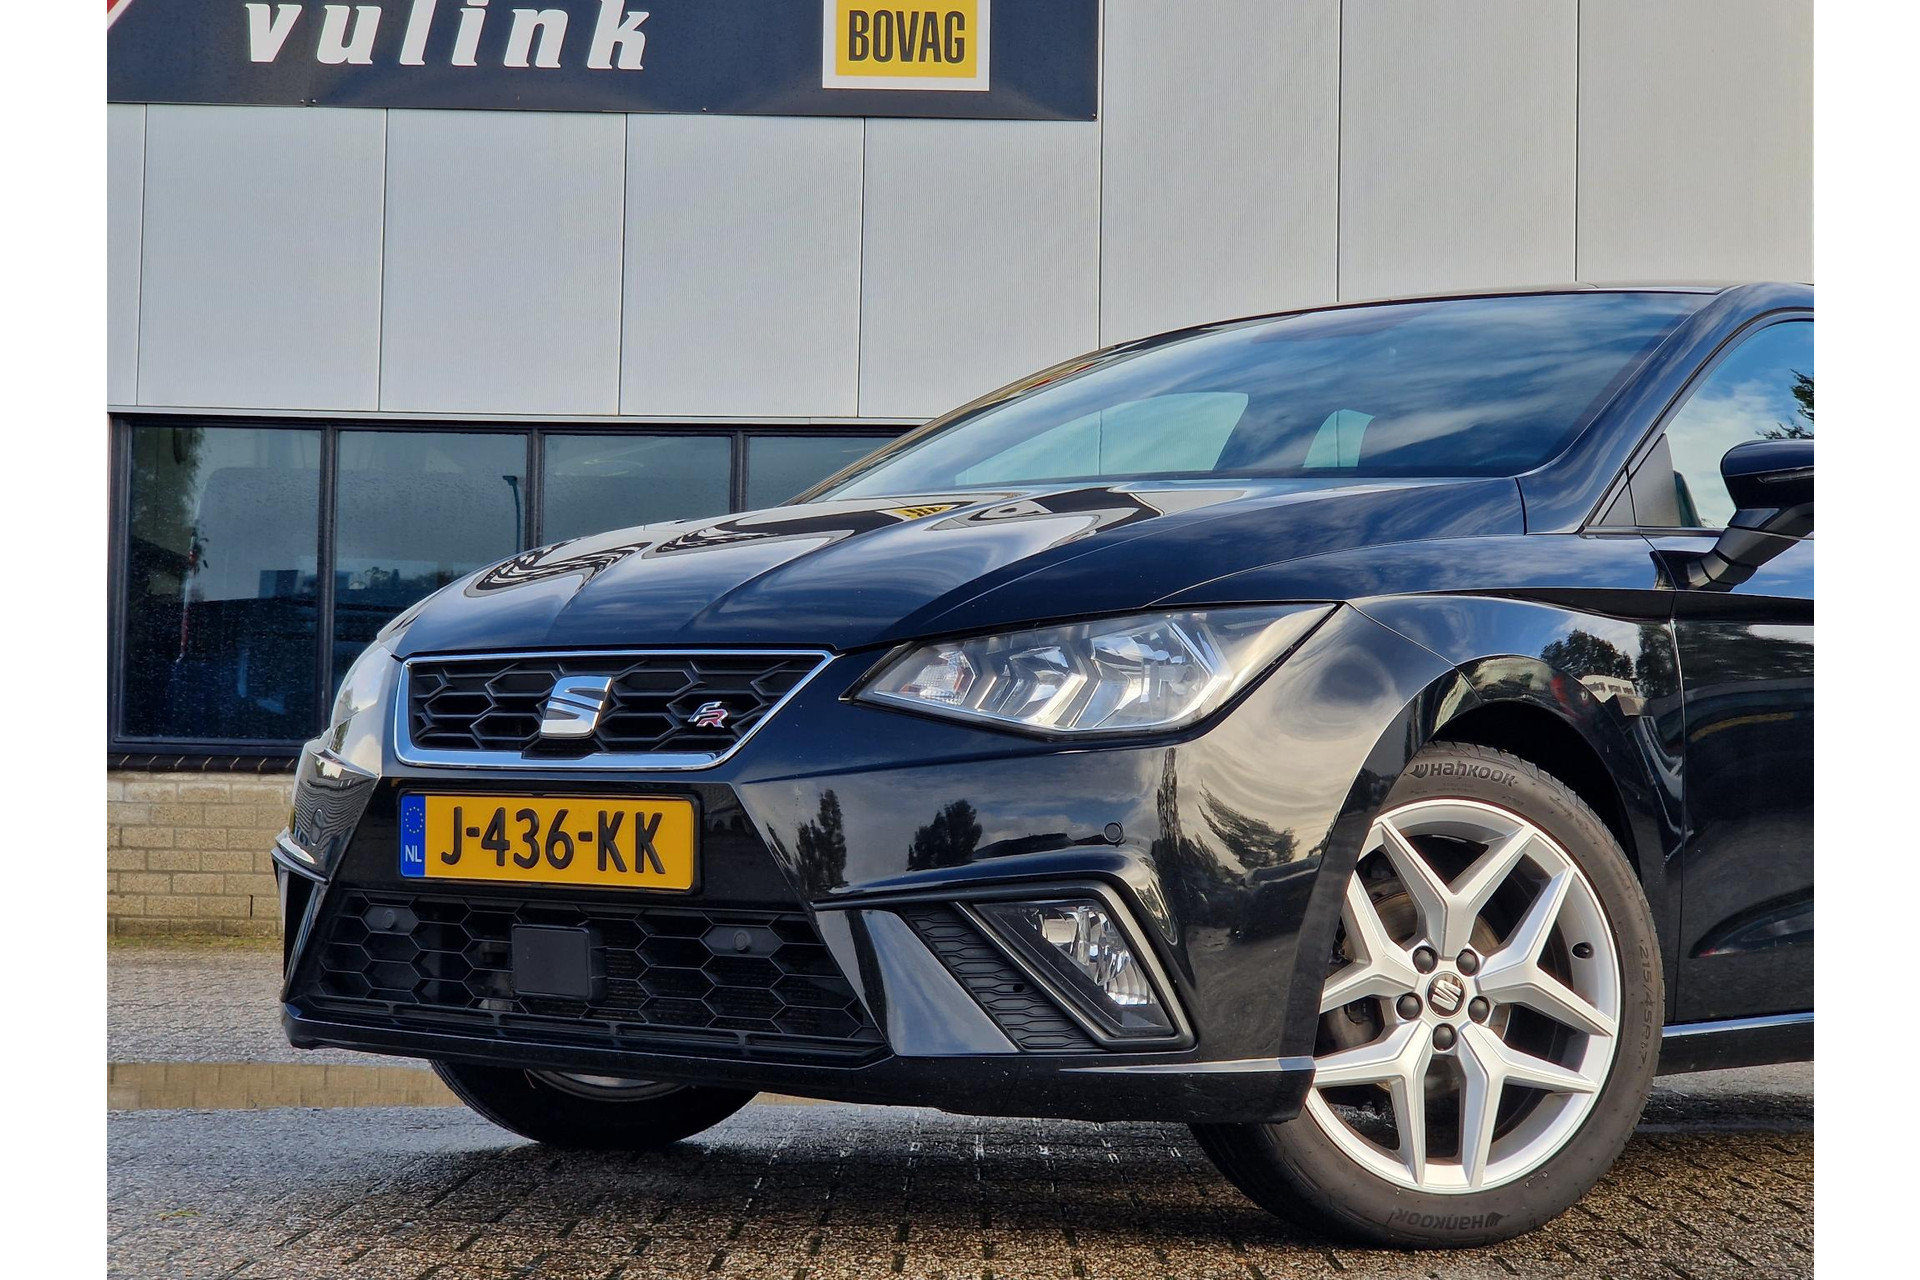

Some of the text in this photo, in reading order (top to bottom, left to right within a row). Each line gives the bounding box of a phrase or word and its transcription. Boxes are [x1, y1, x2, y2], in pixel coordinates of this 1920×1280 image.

[245, 0, 650, 70] vulink
[848, 9, 966, 64] BOVAG
[405, 845, 422, 863] NL
[441, 806, 666, 874] J-436-KK
